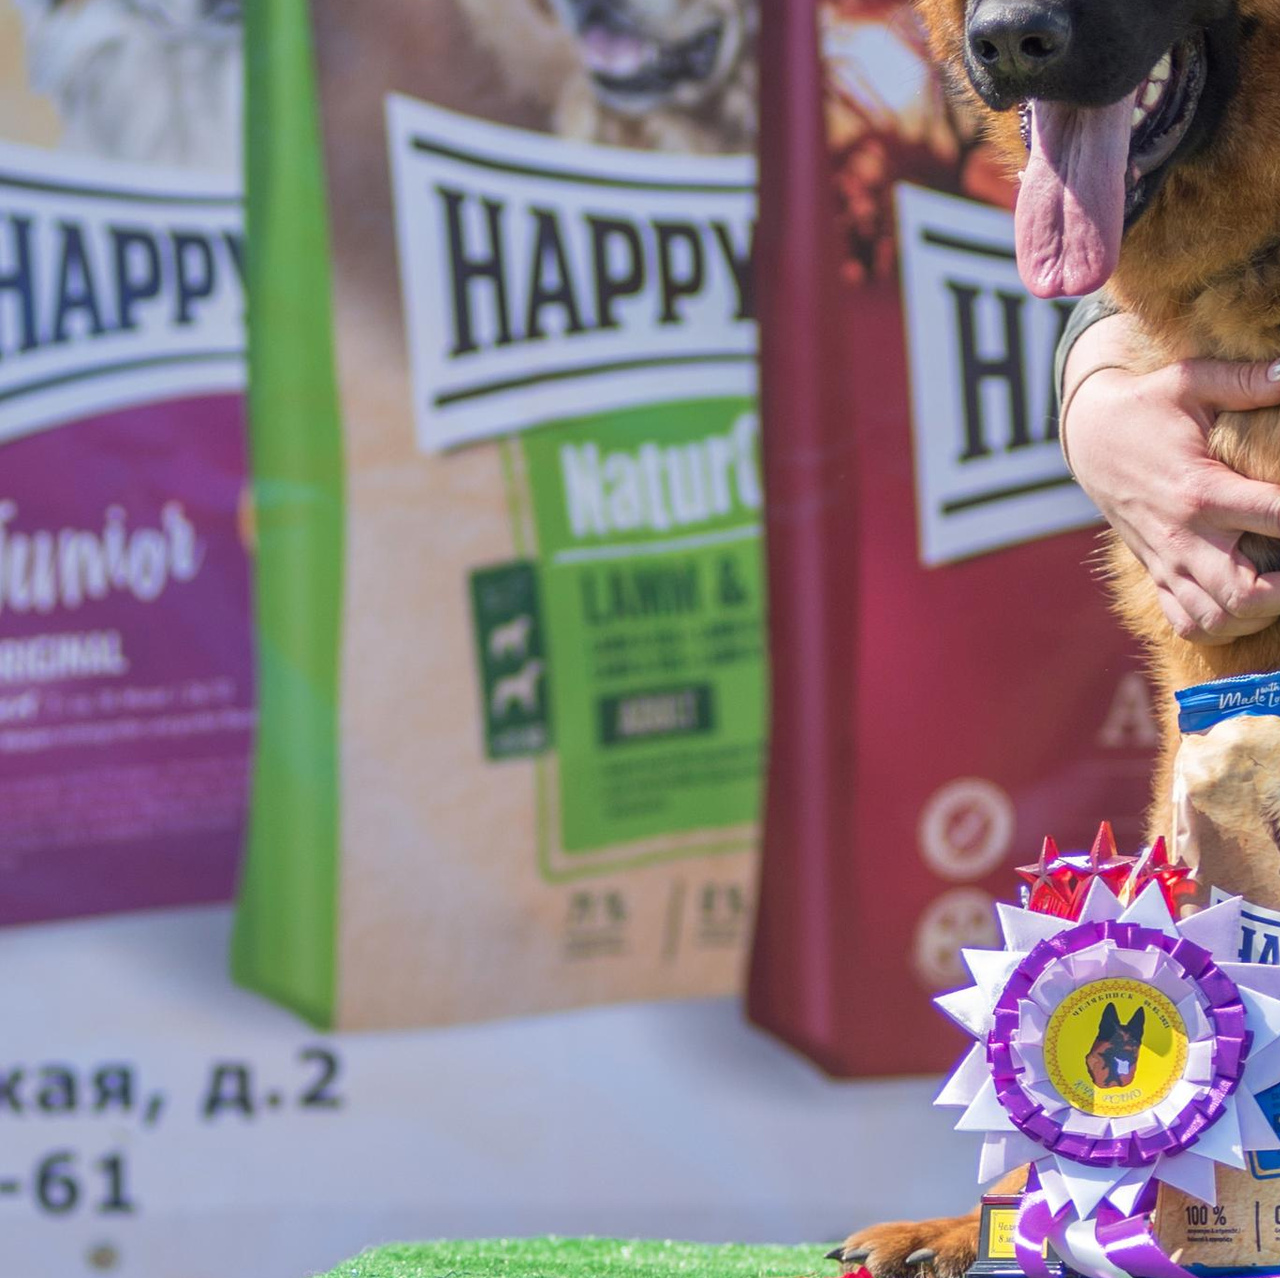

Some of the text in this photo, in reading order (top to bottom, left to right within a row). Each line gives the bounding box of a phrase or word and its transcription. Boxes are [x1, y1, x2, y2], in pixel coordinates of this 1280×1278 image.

[0, 500, 207, 614] unior
[1219, 688, 1267, 709] Made
[1185, 1204, 1227, 1226] 100 %
